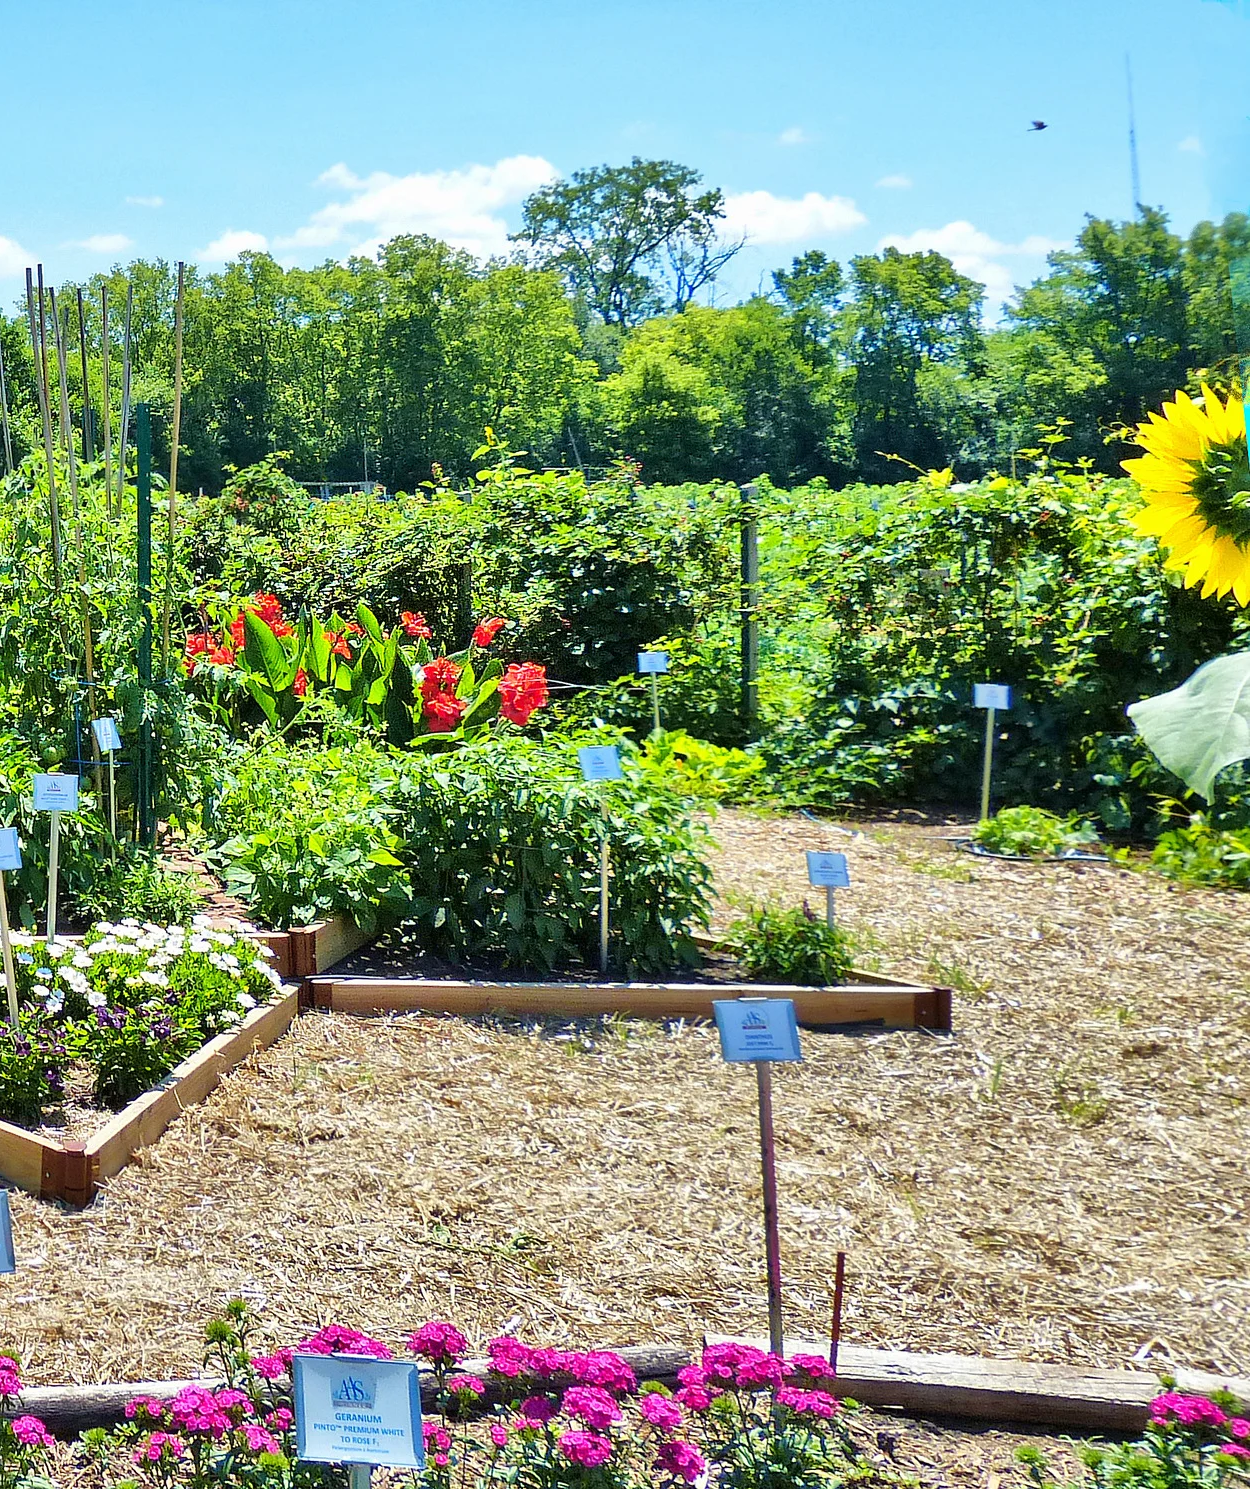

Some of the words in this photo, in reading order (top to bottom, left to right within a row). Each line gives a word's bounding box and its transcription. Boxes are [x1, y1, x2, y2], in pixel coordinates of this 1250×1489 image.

[335, 1412, 382, 1423] GERANIUM
[343, 1425, 380, 1436] PREMIUM
[381, 1428, 405, 1437] WHITE
[340, 1435, 351, 1443] TO
[352, 1436, 370, 1445] ROSE
